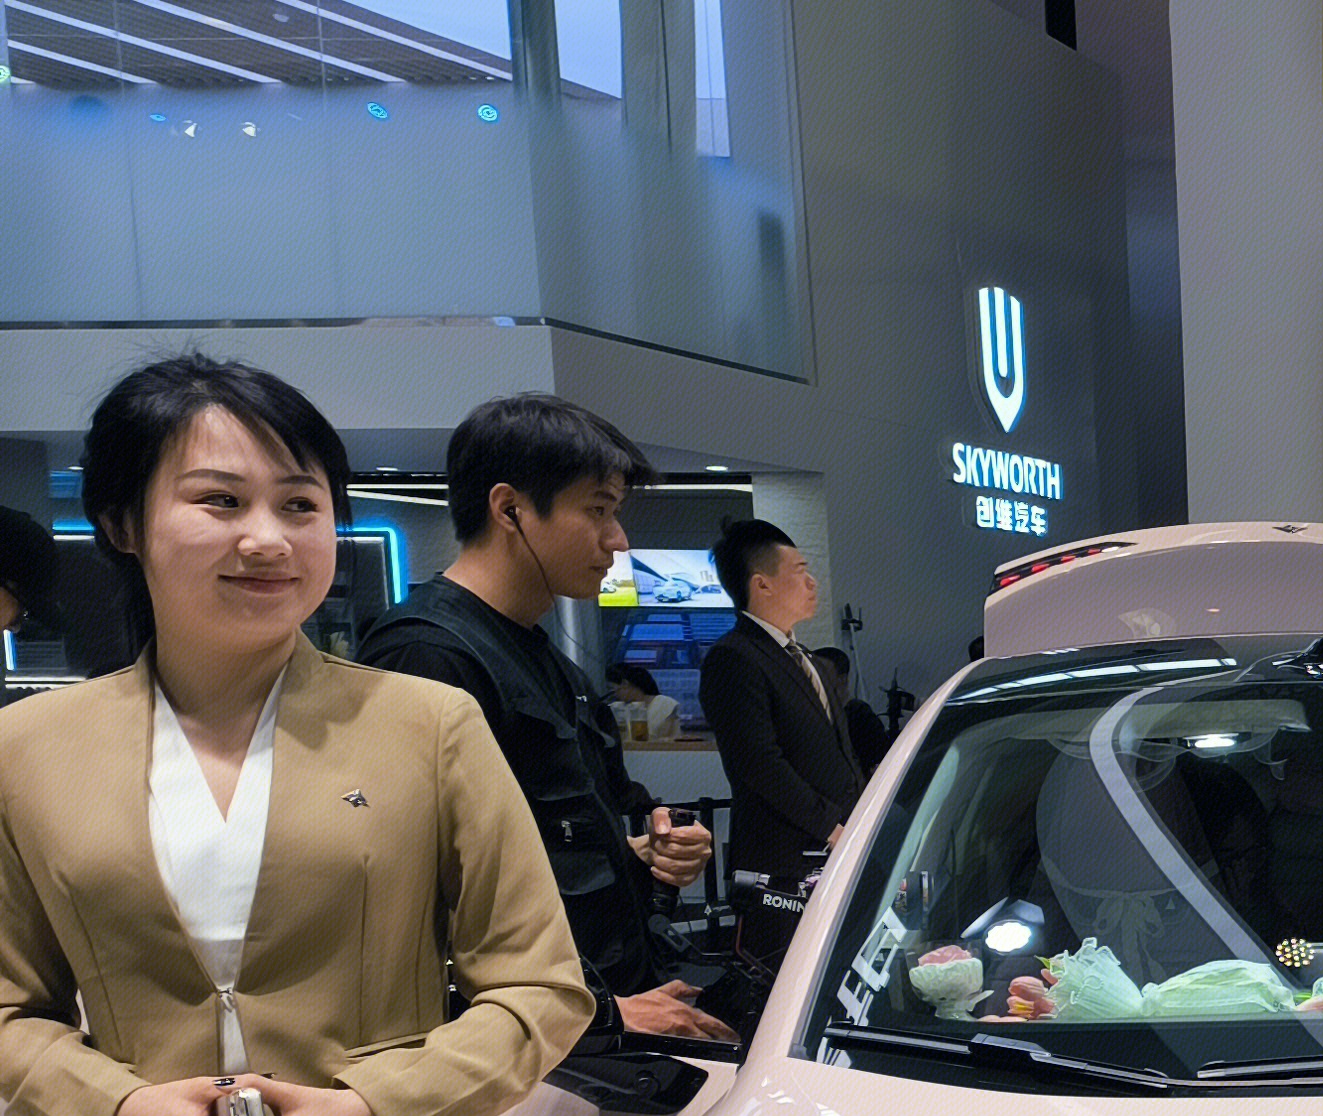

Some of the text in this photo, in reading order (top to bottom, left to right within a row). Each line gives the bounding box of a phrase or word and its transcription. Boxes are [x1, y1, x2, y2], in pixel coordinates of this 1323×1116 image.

[952, 442, 1062, 500] SKYWORTH
[976, 495, 1048, 537] 创维汽车
